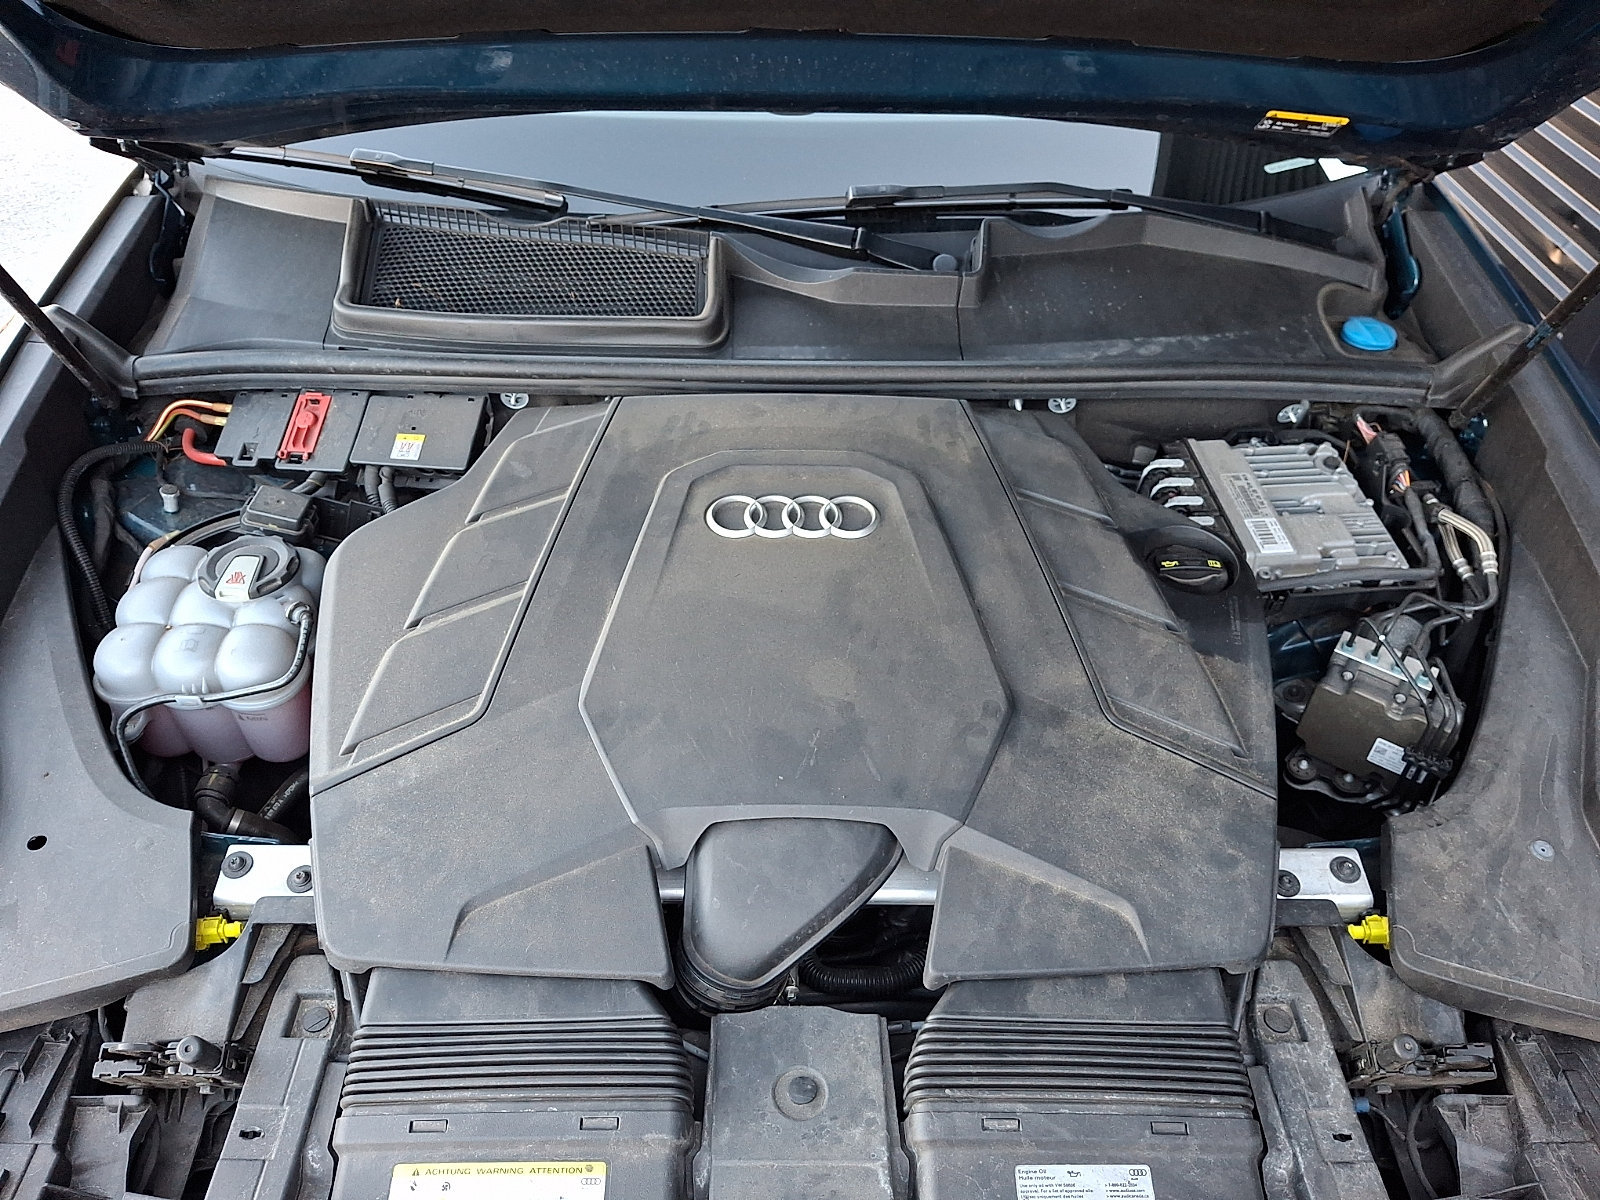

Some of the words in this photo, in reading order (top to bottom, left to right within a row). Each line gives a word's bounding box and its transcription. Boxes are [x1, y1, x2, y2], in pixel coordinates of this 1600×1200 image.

[424, 1166, 472, 1176] ACHTUNG
[476, 1166, 524, 1175] WARNING
[529, 1166, 584, 1174] ATTENTION
